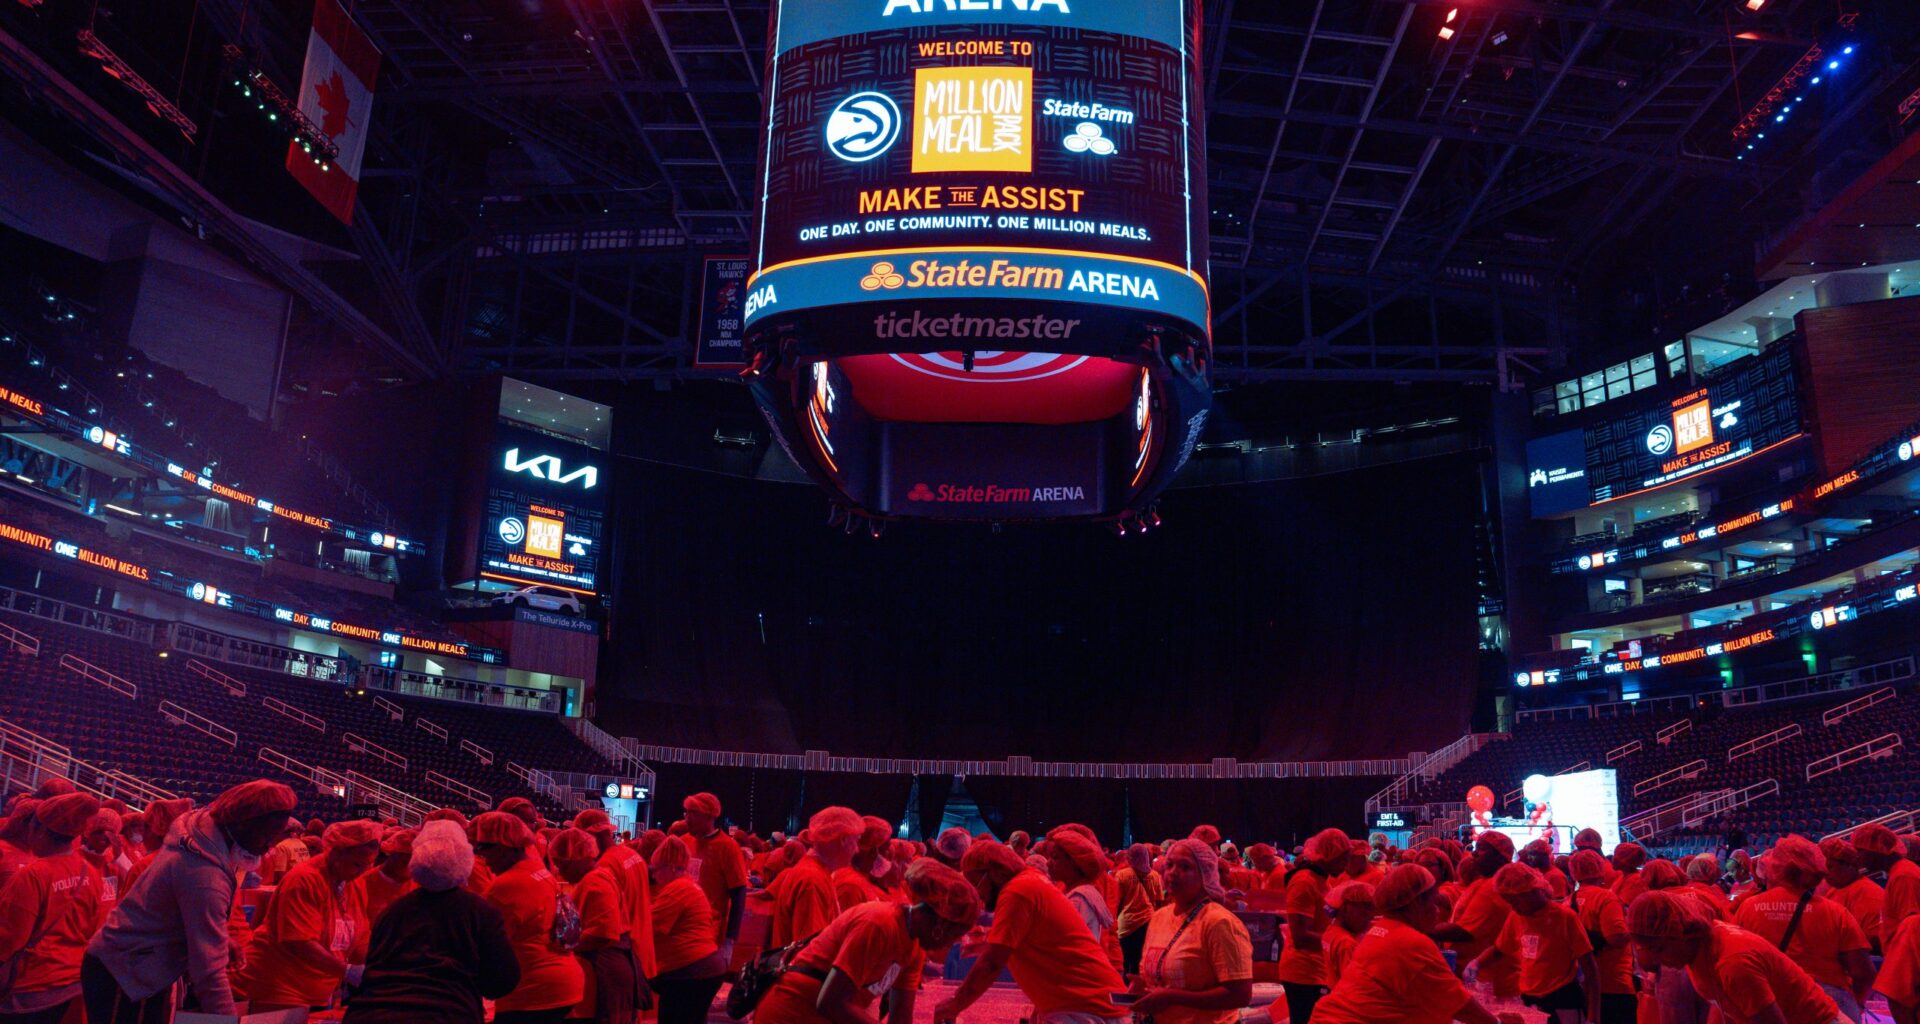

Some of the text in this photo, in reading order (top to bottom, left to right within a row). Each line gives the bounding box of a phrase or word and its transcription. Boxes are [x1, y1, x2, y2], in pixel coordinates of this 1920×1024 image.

[919, 41, 1032, 57] WELCOME TO
[923, 78, 1023, 115] MILLION
[921, 115, 992, 155] MEAL
[992, 115, 1022, 155] PACK
[858, 185, 1085, 214] MAKE THE ASSIST
[799, 215, 1152, 242] ONE DAY. ONE COMMUNITY. ONE MILLION MEALS.
[718, 270, 744, 279] HAWKS
[727, 261, 748, 271] LOUIS
[1066, 269, 1160, 301] ARENA
[717, 319, 739, 330] 1958
[873, 310, 1081, 340] ticketmaster
[9, 391, 43, 416] MEALS.
[1671, 388, 1708, 407] WELCOME TO
[504, 447, 598, 489] KIA
[1662, 456, 1689, 474] MAKE
[1699, 441, 1731, 461] ASSIST
[1833, 470, 1860, 489] MEALS.
[167, 462, 331, 530] ONE DAY. ONE COMMUNITY. ONE MILLION MEALS.
[1032, 486, 1085, 502] ARENA
[530, 504, 565, 518] WELCOME TO
[1662, 536, 1681, 549] ONE
[1680, 532, 1698, 545] DAY.
[1698, 526, 1717, 540] ONE
[1717, 511, 1763, 534] COMMUNITY.
[1762, 503, 1780, 518] ONE
[55, 541, 78, 558] ONE
[78, 547, 117, 570] MILLION
[117, 560, 149, 581] MEALS.
[508, 553, 535, 567] MAKE
[544, 560, 575, 574] ASSIST
[1895, 585, 1917, 601] ONE
[275, 608, 468, 656] ONE DAY. ONE COMMUNITY. ONE MILLION MEALS.
[522, 611, 593, 631] The Telluride X-Pro
[1604, 629, 1775, 674] ONE DAY. ONE COMMUNITY. ONE MILLION MEALS.
[1376, 819, 1404, 827] FIRST-AID
